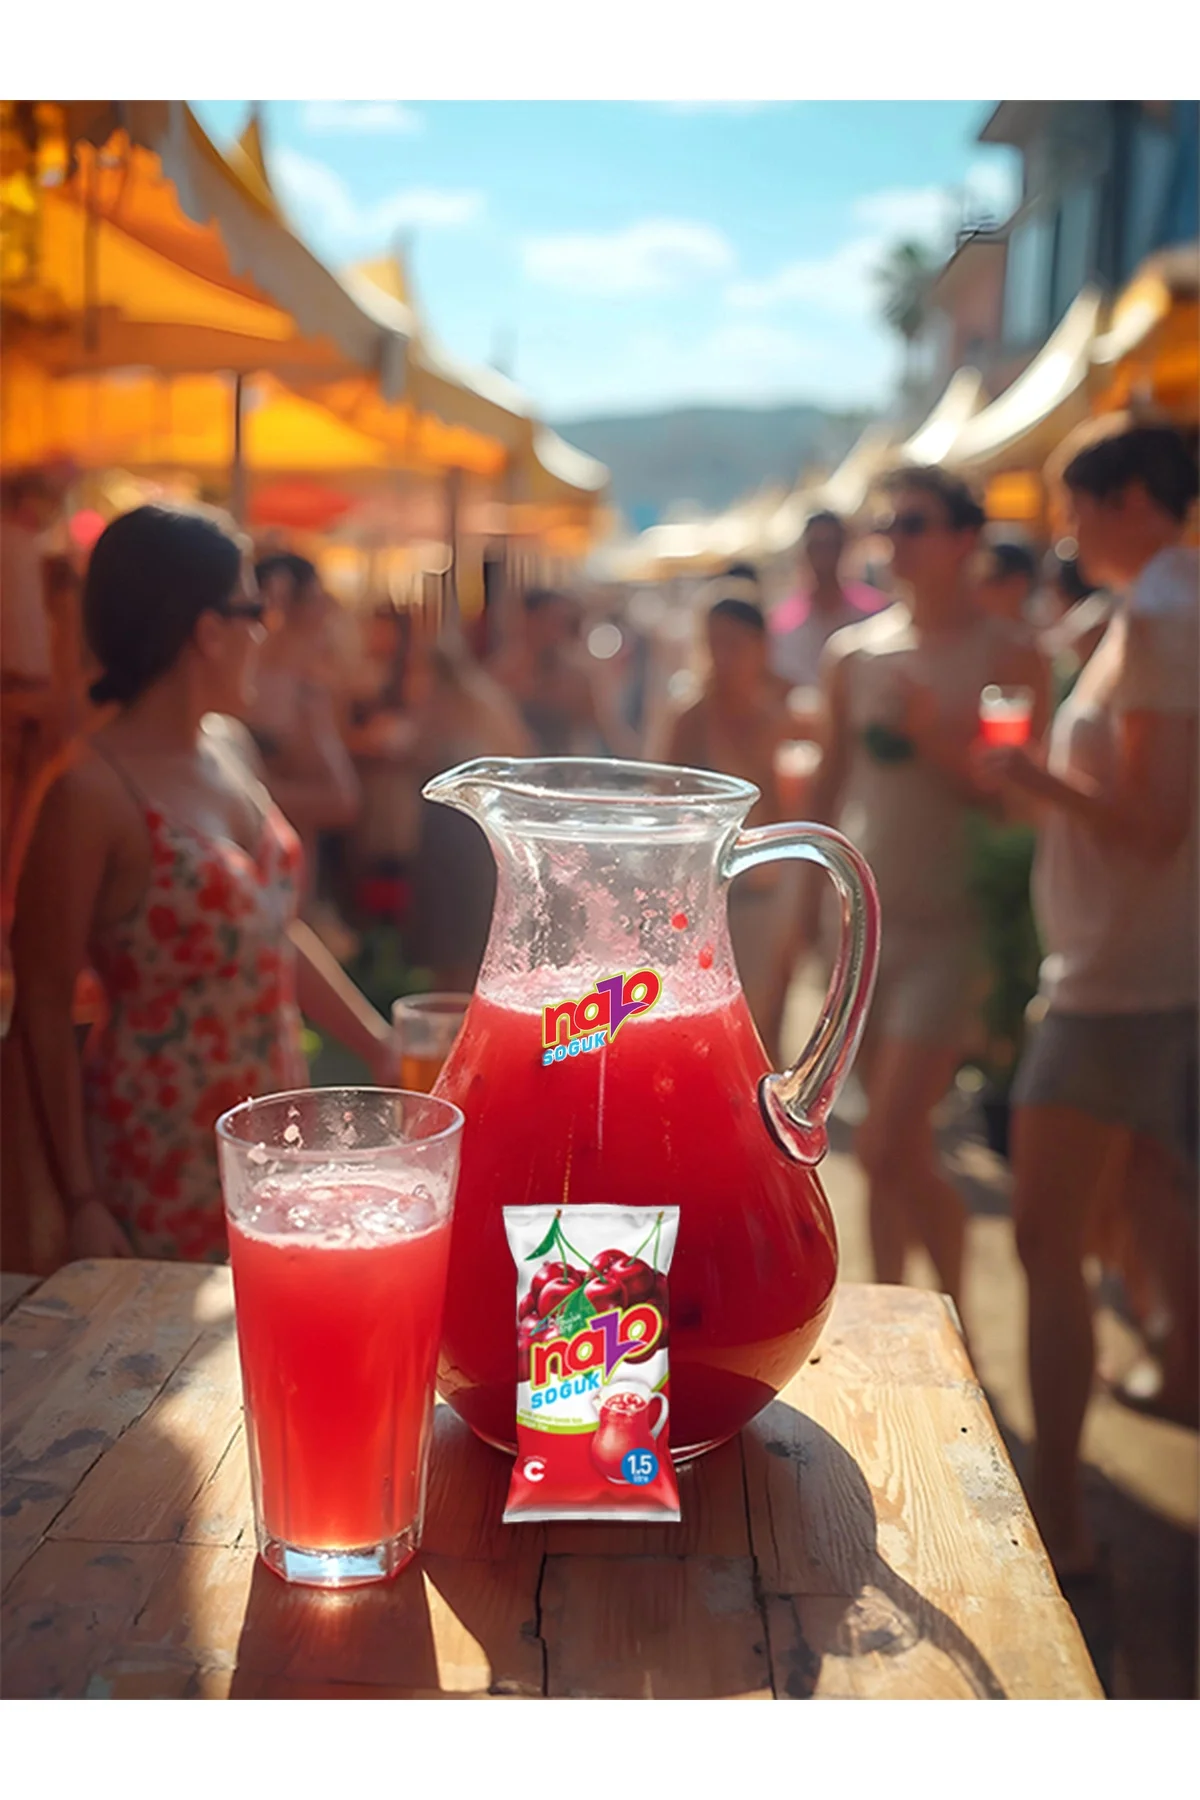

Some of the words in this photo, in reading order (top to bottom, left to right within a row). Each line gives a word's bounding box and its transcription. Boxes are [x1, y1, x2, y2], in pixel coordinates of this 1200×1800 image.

[542, 1031, 607, 1067] SOĞUK
[531, 1371, 600, 1409] SOĞUK
[524, 1461, 545, 1482] C
[627, 1454, 653, 1475] 1.5
